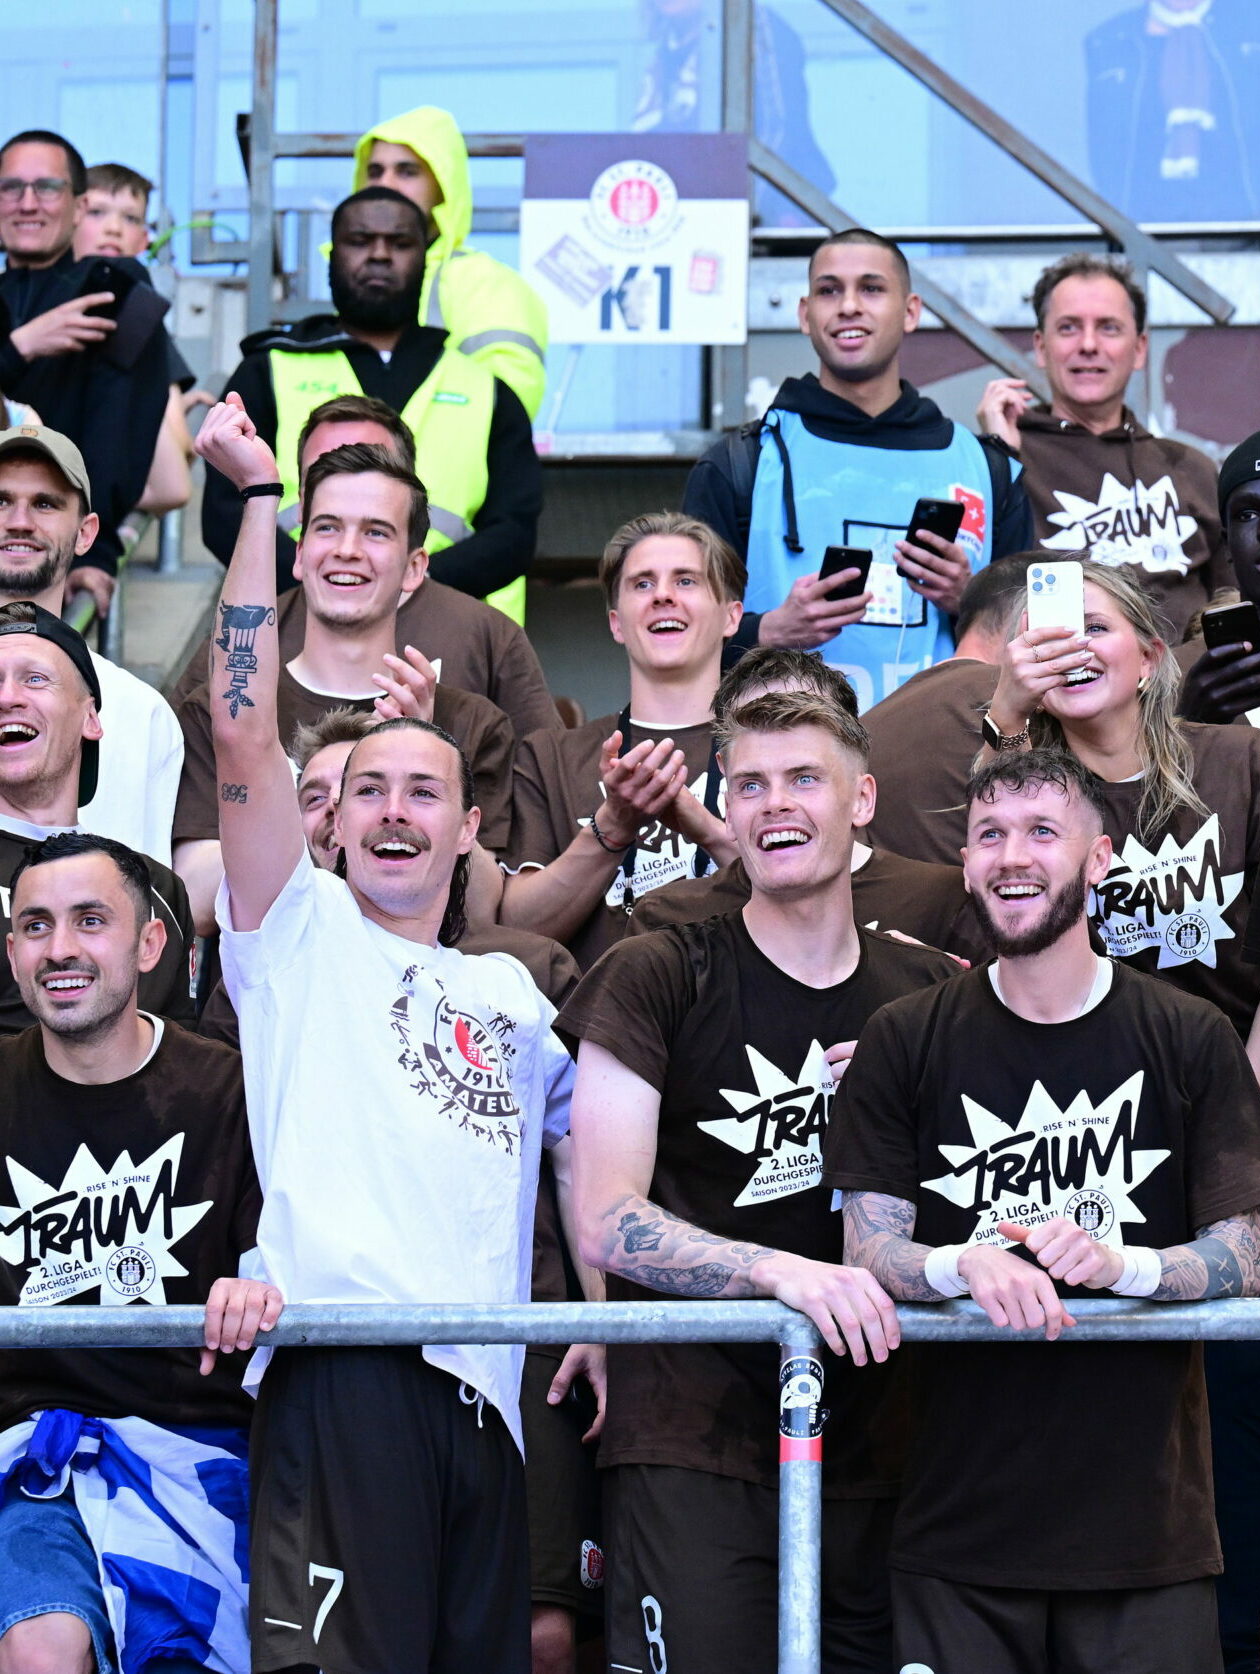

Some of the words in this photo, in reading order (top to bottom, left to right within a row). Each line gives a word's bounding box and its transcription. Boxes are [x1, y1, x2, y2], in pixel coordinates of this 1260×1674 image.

[600, 265, 672, 331] K1
[1067, 490, 1182, 549] TRAUM
[615, 860, 687, 890] DCHGESPIELT!
[642, 857, 672, 872] LIGA
[1139, 864, 1158, 876] RISE
[1173, 855, 1198, 865] SHINE
[1115, 922, 1146, 936] LIGA
[1168, 925, 1178, 936] FC
[1189, 915, 1208, 934] PAULI
[1179, 948, 1197, 956] 1910
[439, 1002, 457, 1025] FC
[463, 1020, 498, 1063] AULI
[429, 1058, 516, 1113] AMATEU
[736, 1085, 835, 1158] TRA
[1043, 1122, 1064, 1132] RISE
[1082, 1116, 1110, 1126] SHINE
[770, 1158, 785, 1171] 2.
[786, 1152, 819, 1168] LIGA
[953, 1099, 1132, 1211] TRAUM
[86, 1183, 106, 1193] RISE
[123, 1174, 151, 1185] SHINE
[753, 1164, 824, 1186] DURCHGESPIE
[751, 1187, 778, 1197] SAISON
[779, 1180, 810, 1192] 2023/24
[3, 1158, 173, 1265] TRAUM
[989, 1211, 1004, 1223] 2.
[1006, 1202, 1041, 1219] LIGA
[1066, 1204, 1075, 1215] FC
[1073, 1195, 1087, 1206] ST.
[1090, 1192, 1111, 1215] PAULI
[975, 1210, 1059, 1241] DURESPIELT!
[39, 1267, 53, 1279] 2.
[55, 1259, 84, 1275] LIGA
[109, 1260, 118, 1271] FC
[115, 1250, 128, 1262] ST.
[130, 1249, 153, 1270] PAULI
[26, 1266, 102, 1295] DURCHGESPIELT!
[122, 1286, 141, 1294] 1910
[50, 1286, 77, 1299] 2023/24
[308, 1562, 345, 1645] 7
[641, 1595, 667, 1674] 8
